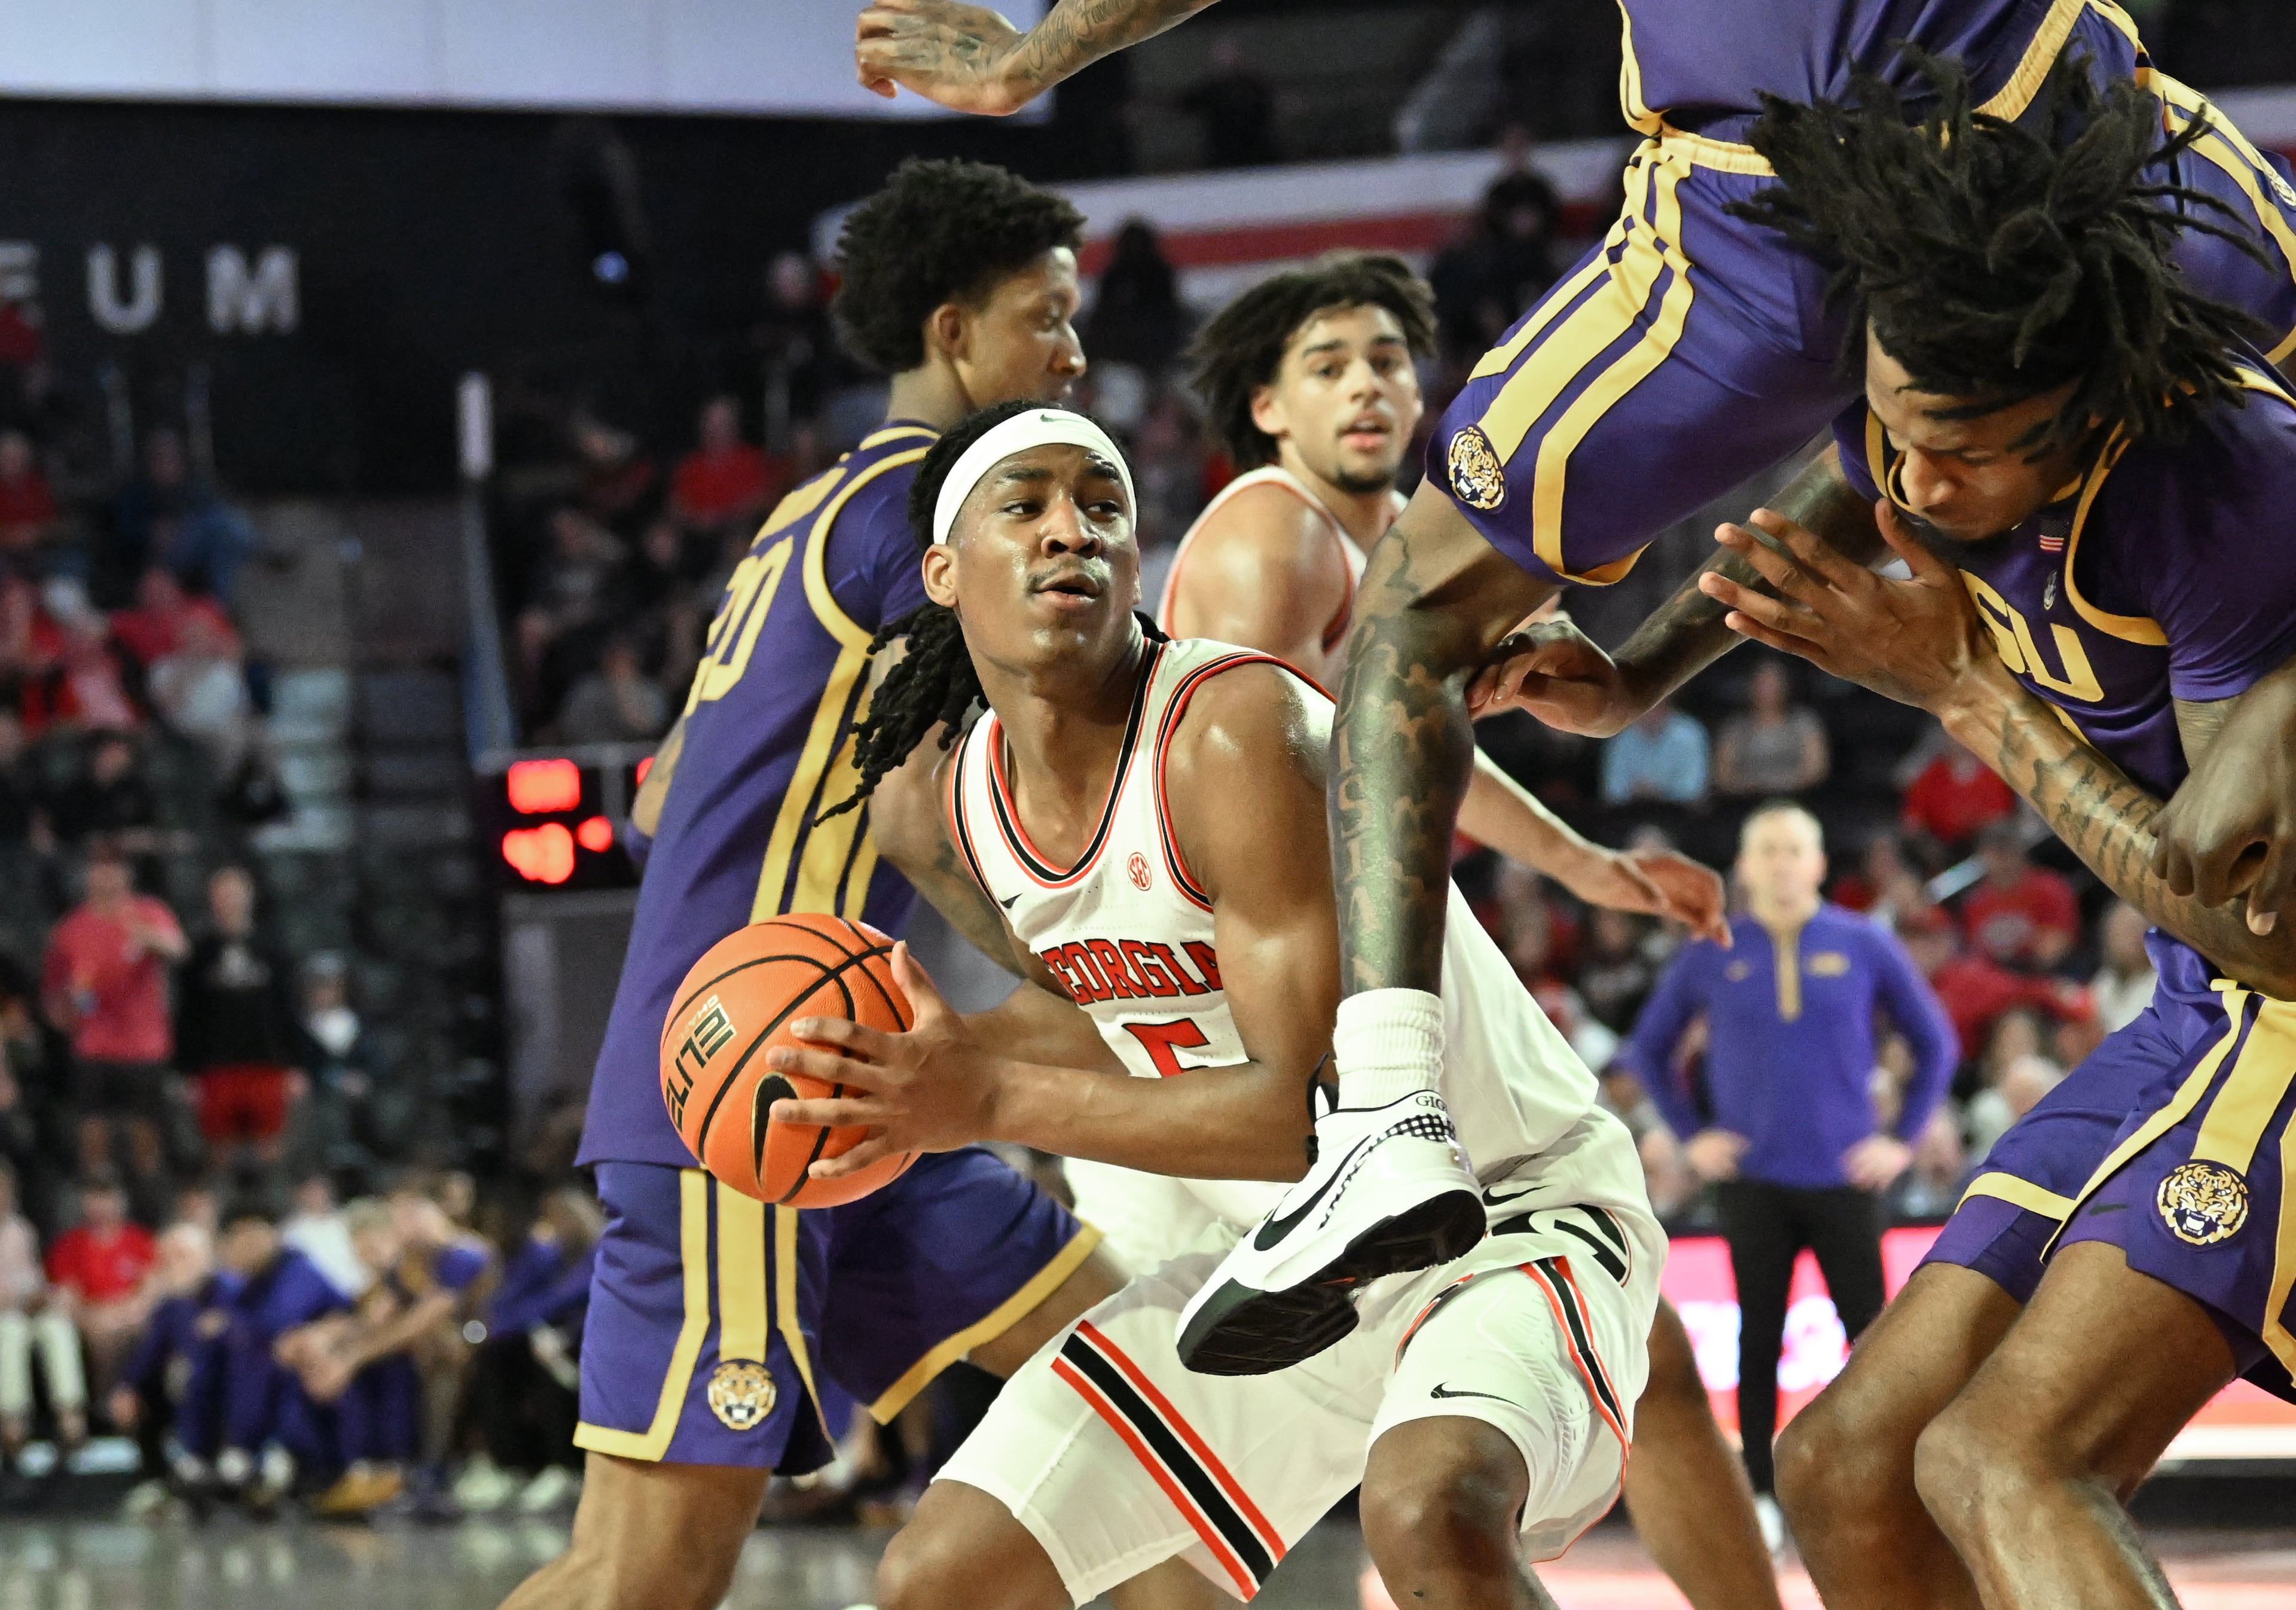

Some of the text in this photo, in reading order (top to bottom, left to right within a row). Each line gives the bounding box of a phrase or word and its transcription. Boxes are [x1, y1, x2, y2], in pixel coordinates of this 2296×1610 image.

[1958, 568, 2105, 702] SU
[1129, 856, 1150, 888] SEC
[1040, 938, 1223, 1006] EORGIA
[1415, 1095, 1448, 1114] GIG
